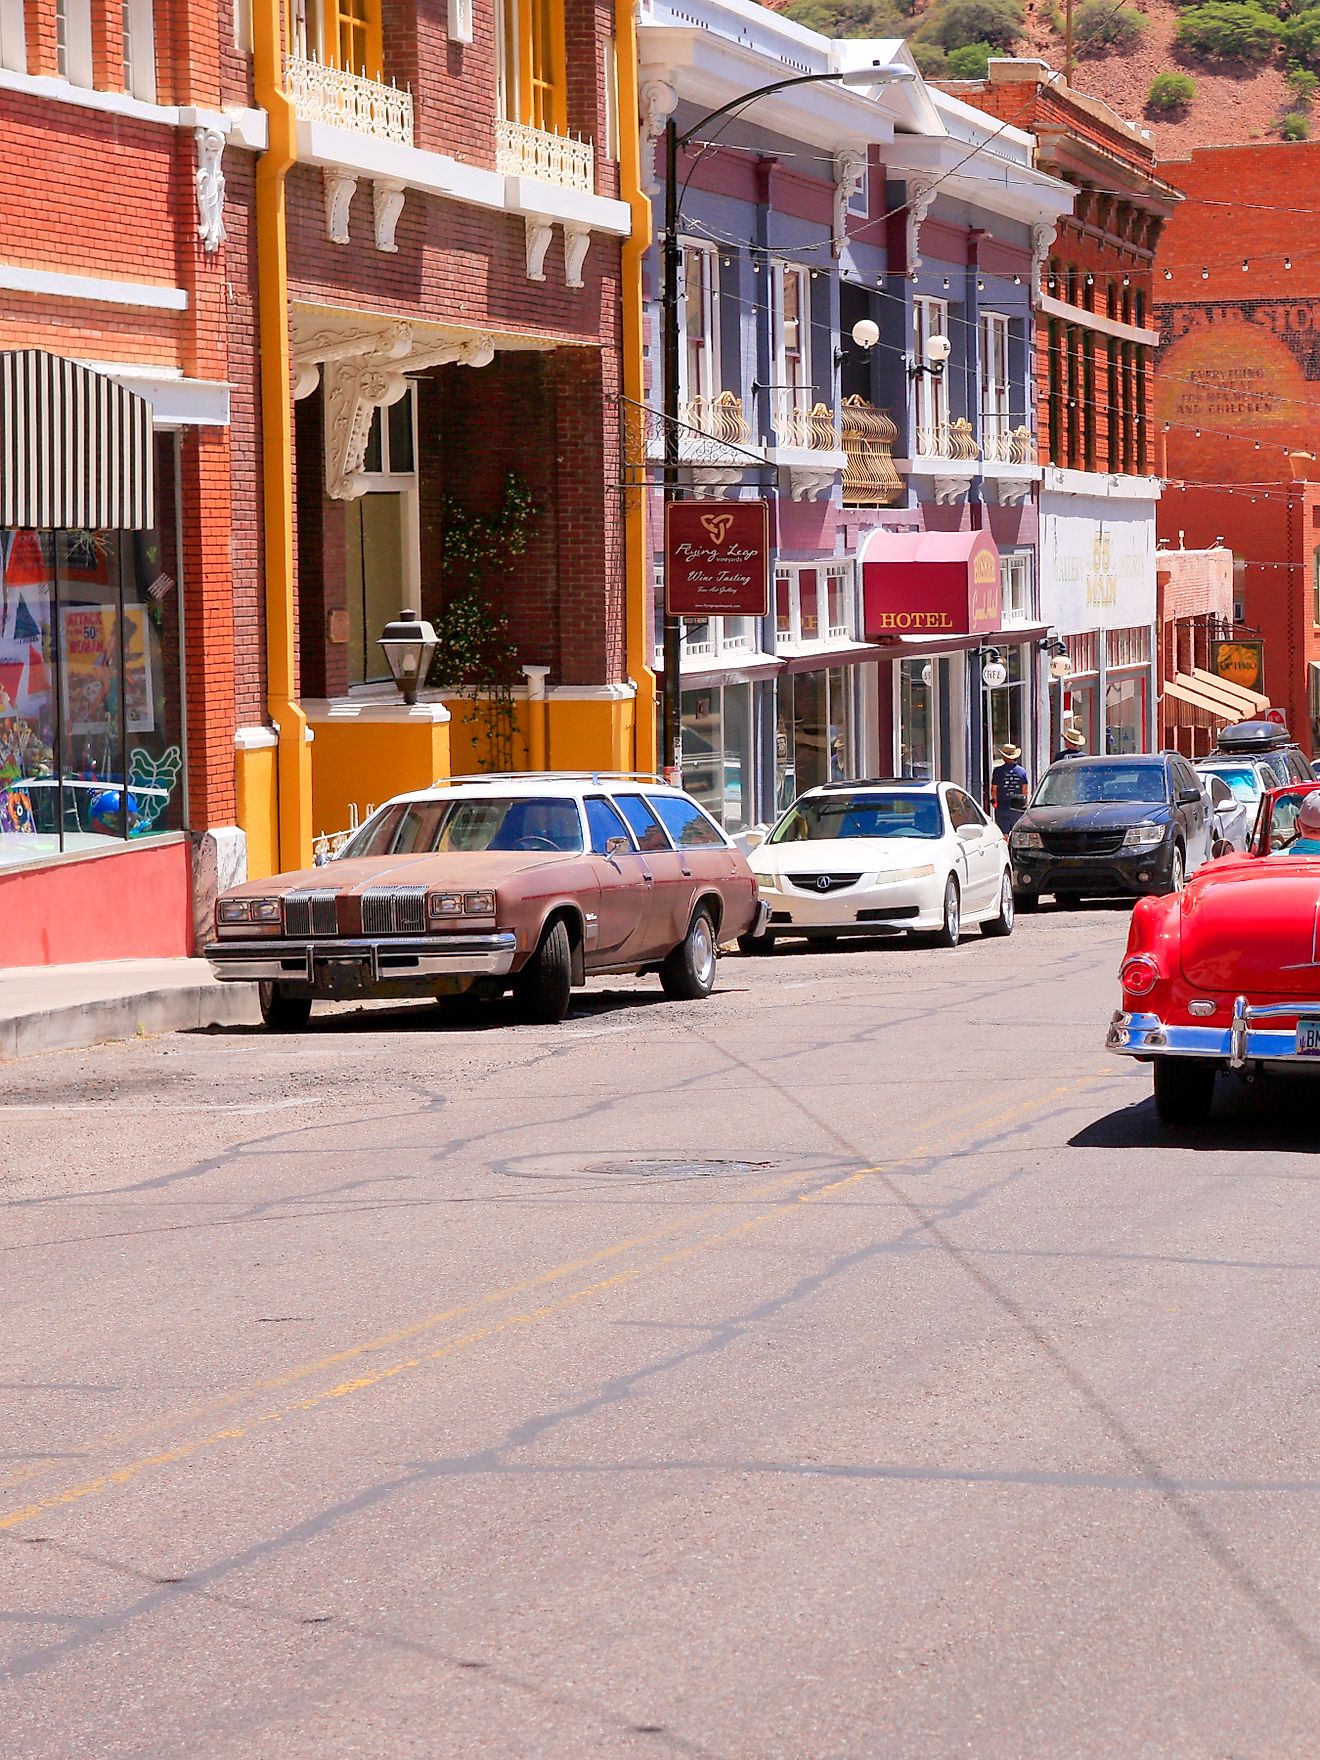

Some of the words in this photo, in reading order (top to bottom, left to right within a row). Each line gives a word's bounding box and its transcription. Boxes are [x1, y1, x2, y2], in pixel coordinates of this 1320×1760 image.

[675, 543, 719, 562] Flying
[727, 543, 758, 560] Leap
[687, 570, 713, 582] Wine
[716, 570, 752, 585] Tasting
[880, 612, 953, 628] HOTEL
